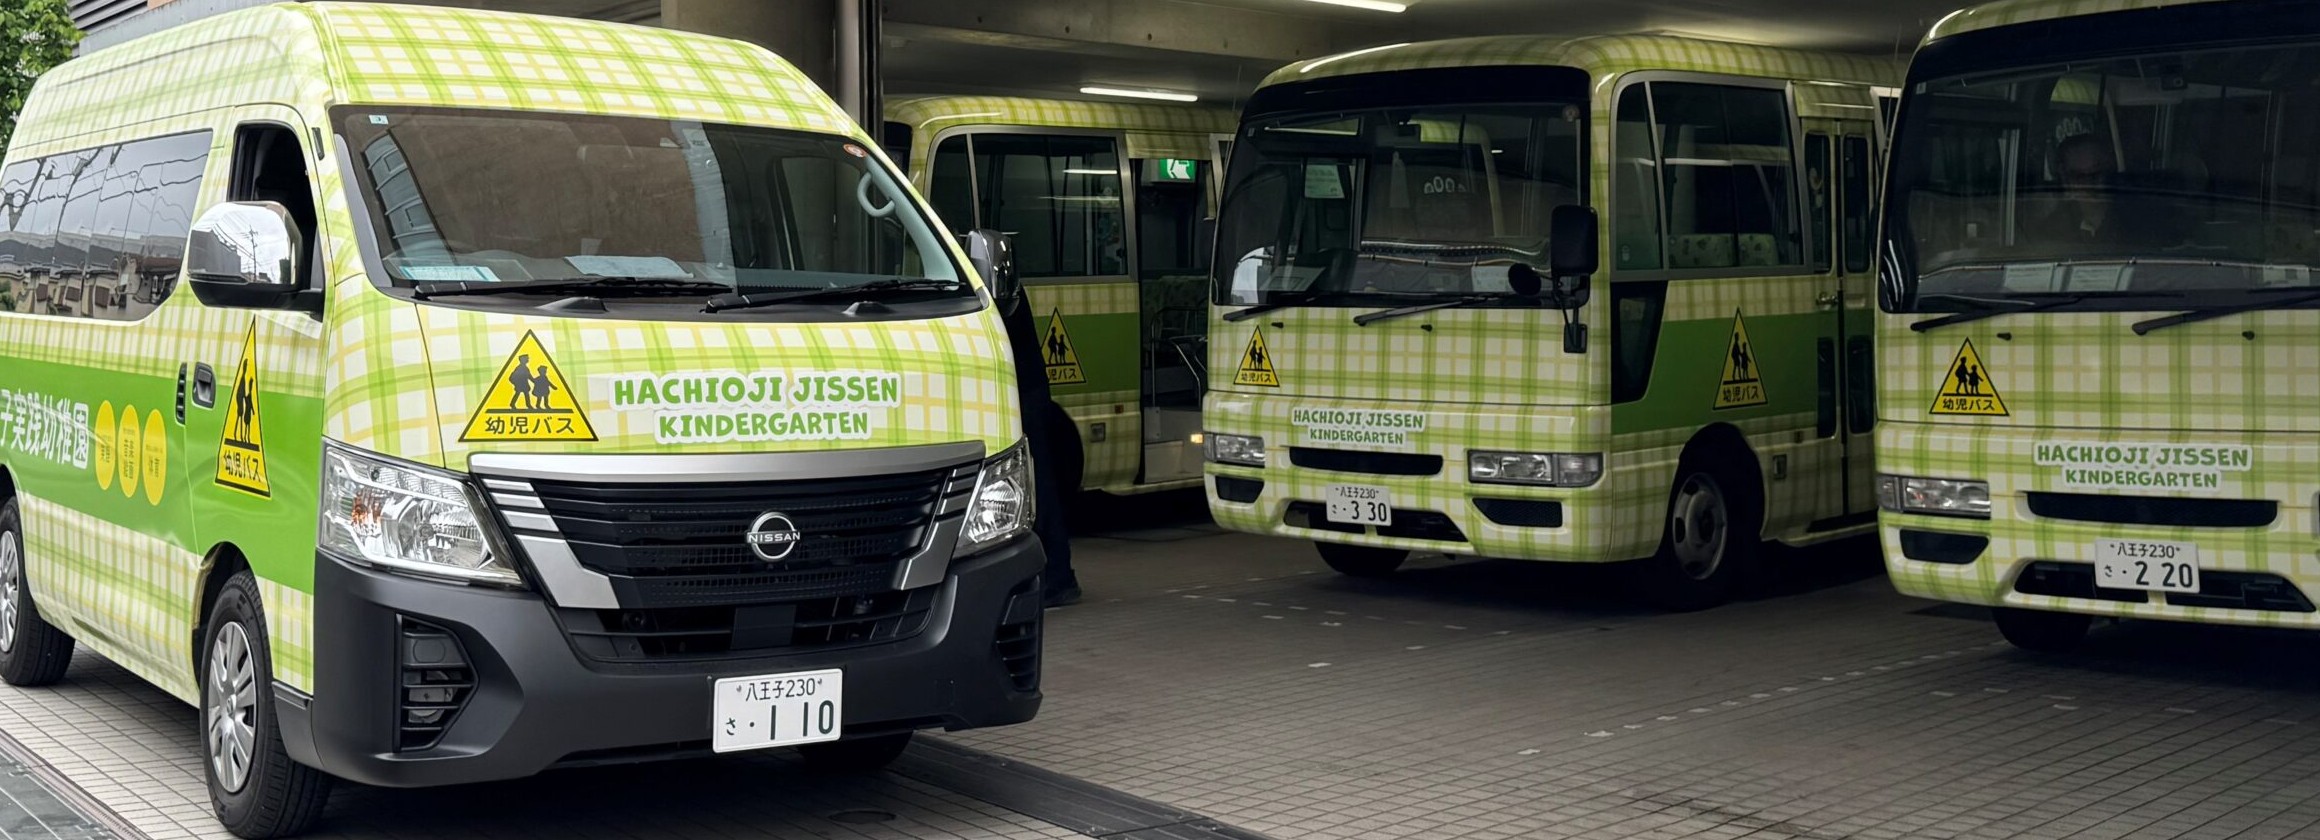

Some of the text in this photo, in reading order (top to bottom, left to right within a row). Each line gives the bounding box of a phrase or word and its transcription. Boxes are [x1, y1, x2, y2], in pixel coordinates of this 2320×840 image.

[1241, 372, 1272, 383] 幼児バス
[614, 376, 898, 405] HACHIOJI JISSEN
[1722, 385, 1759, 402] 幼児バス
[1943, 398, 1995, 411] 幼児バス
[485, 416, 575, 435] 幼児バス
[659, 412, 868, 438] KINDERGARTEN
[1293, 409, 1423, 428] HACHIOJI JISSEN
[1310, 428, 1403, 445] KINDERGARTEN
[2037, 445, 2248, 467] HACHIOJI JISSEN
[223, 450, 261, 482] 幼児バス
[2065, 469, 2218, 488] KINDERGARTEN
[748, 531, 800, 543] NISSAN
[2117, 542, 2175, 559] 八王子230
[745, 677, 816, 701] 八王子230
